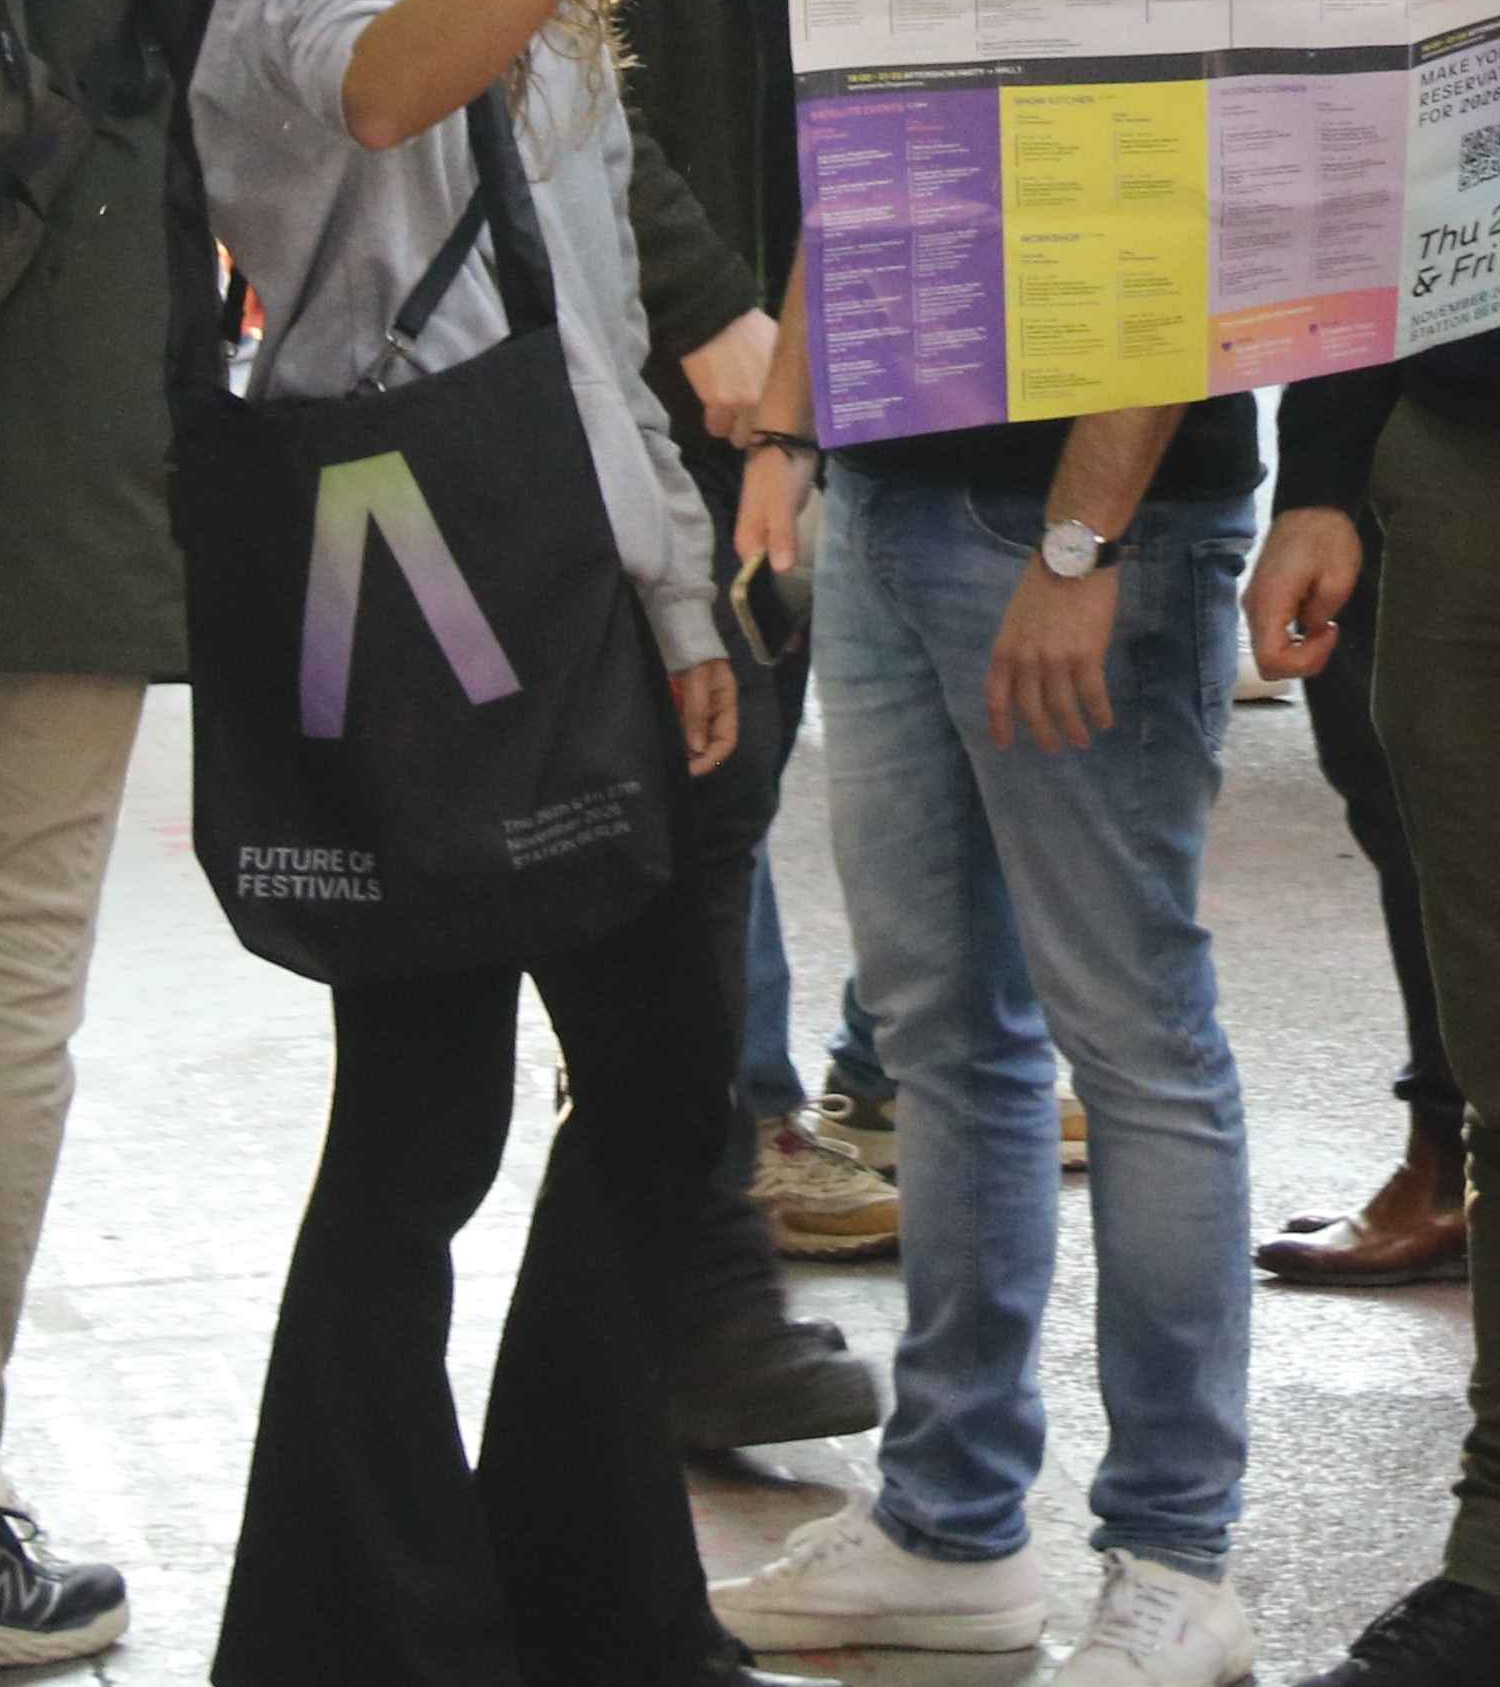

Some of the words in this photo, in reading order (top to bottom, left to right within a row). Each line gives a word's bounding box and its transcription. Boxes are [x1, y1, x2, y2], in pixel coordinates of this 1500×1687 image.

[1420, 57, 1470, 87] MAKE
[1418, 104, 1454, 128] FOR
[1419, 219, 1479, 259] Thu
[1411, 266, 1442, 298] &
[1450, 241, 1498, 288] Fri
[1409, 313, 1471, 343] STATION
[240, 846, 345, 874] FUTURE
[349, 849, 375, 874] OF
[237, 873, 383, 903] FESTIVALS
